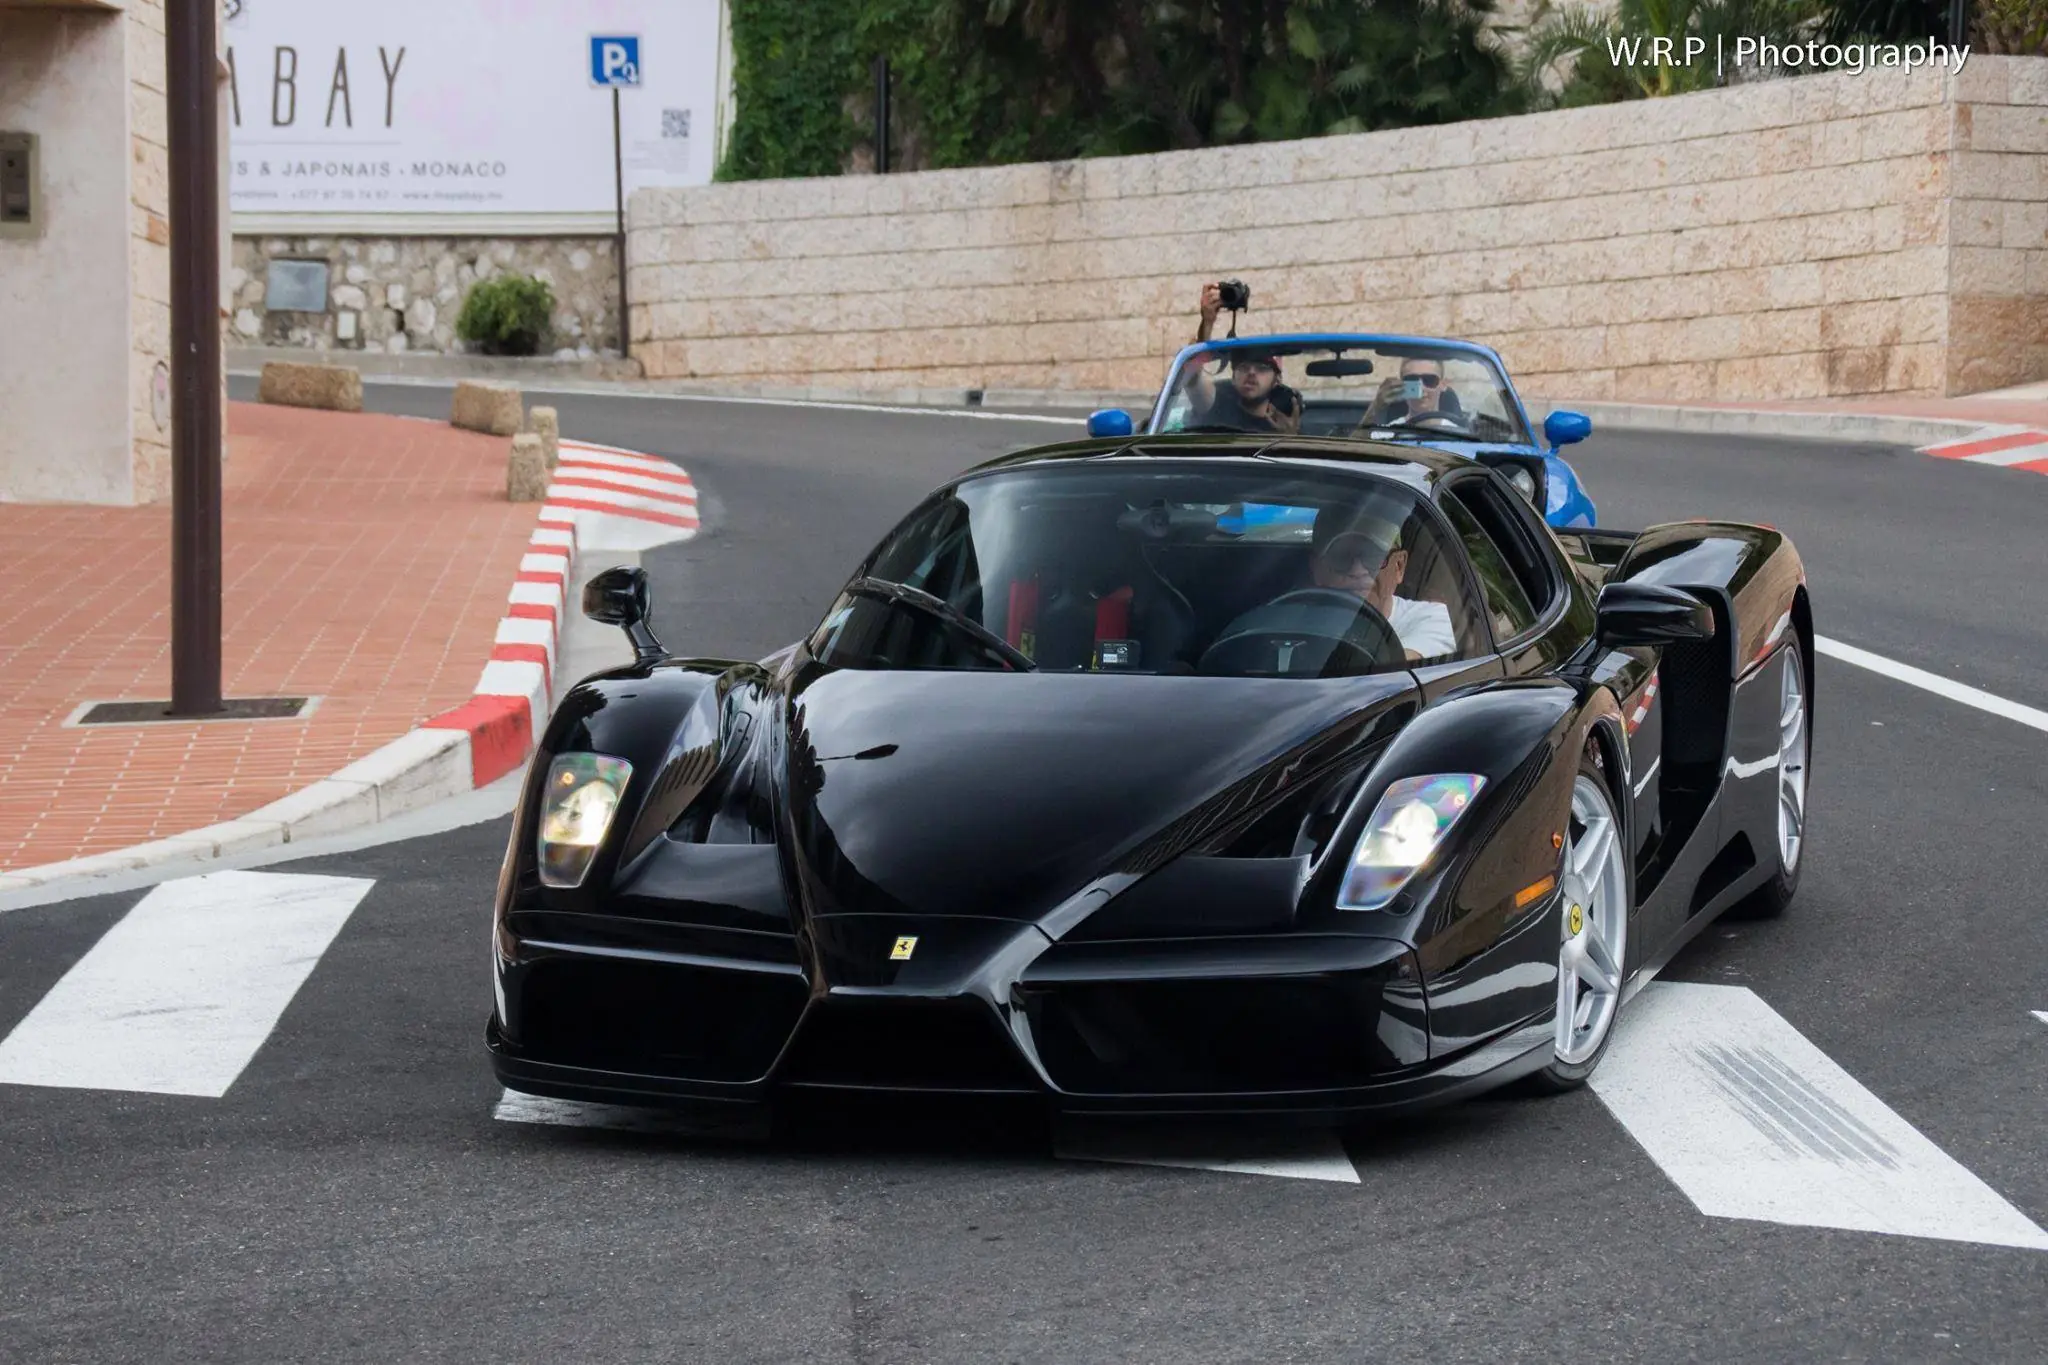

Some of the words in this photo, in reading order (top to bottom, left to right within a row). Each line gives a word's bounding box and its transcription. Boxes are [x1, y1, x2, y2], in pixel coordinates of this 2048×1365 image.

[602, 42, 628, 79] P
[281, 161, 390, 178] JAPONAIS
[412, 160, 507, 178] MONACO
